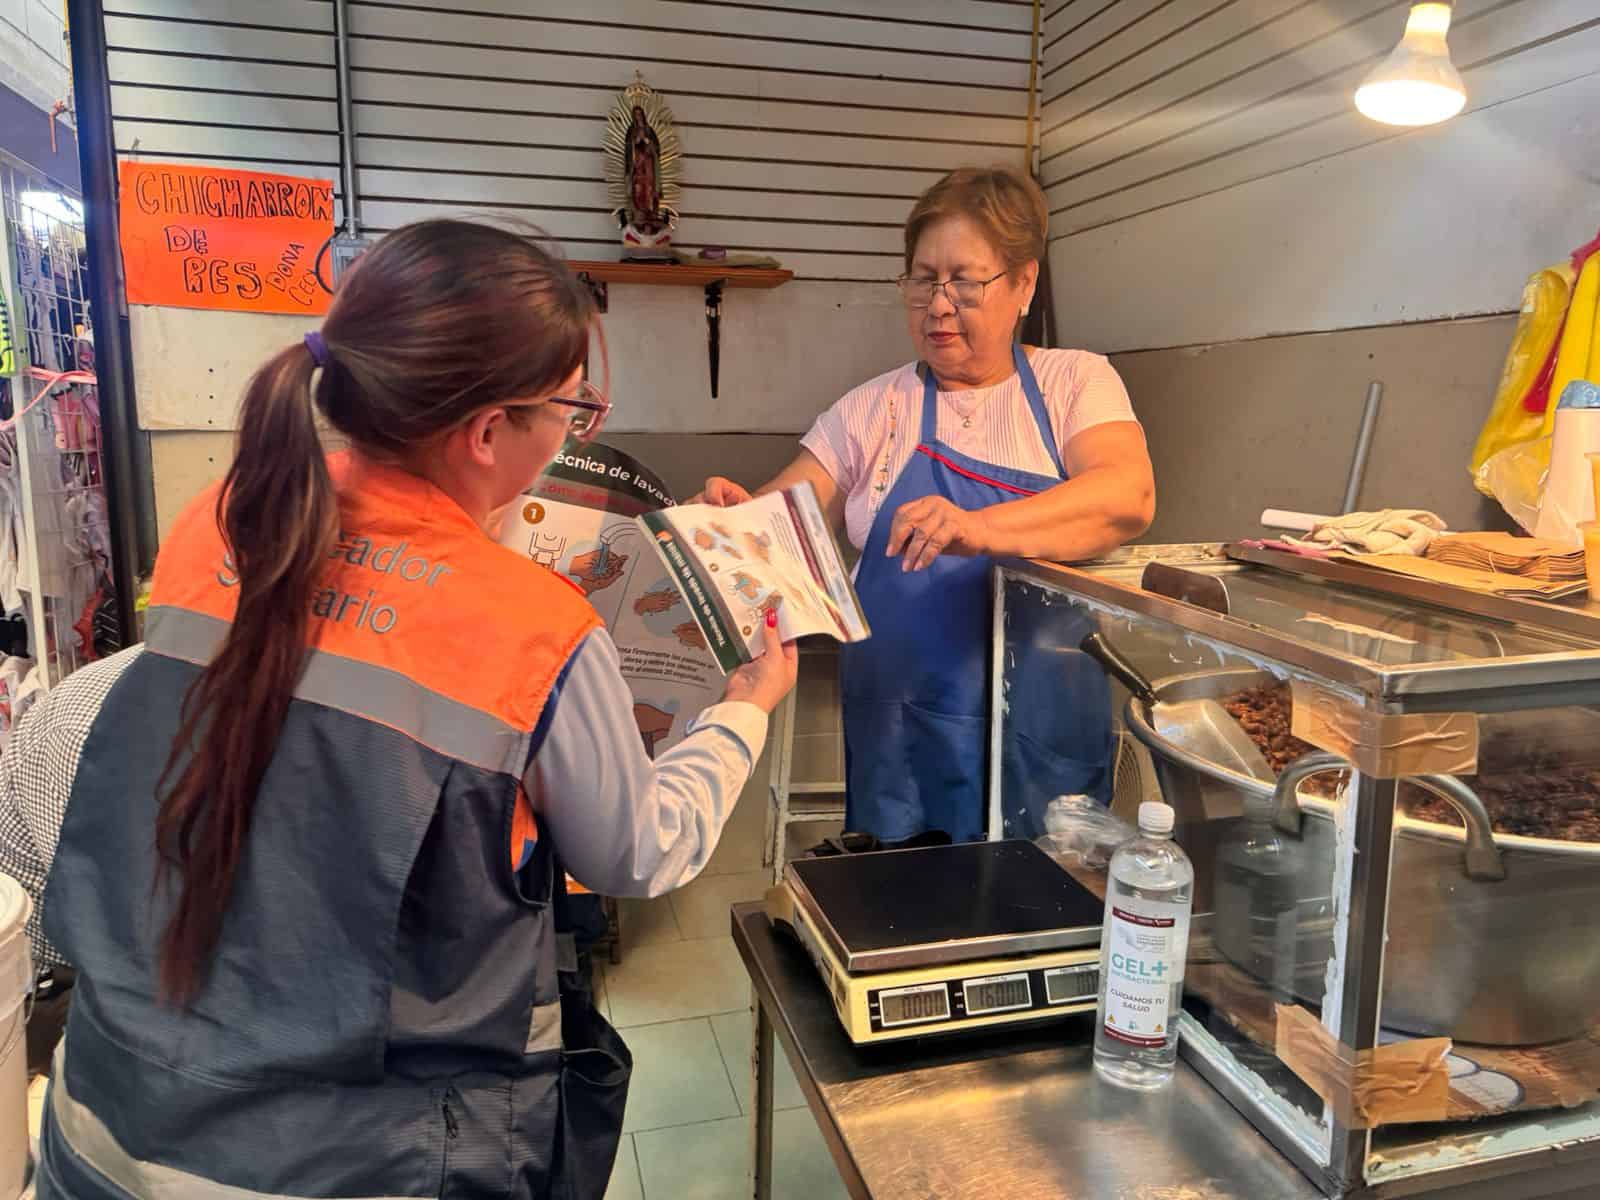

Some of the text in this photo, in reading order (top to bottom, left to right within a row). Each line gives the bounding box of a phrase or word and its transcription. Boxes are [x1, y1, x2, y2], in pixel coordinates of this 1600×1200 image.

[136, 171, 334, 220] CHICHARRON
[164, 225, 208, 254] DE
[183, 256, 263, 300] RES
[553, 449, 605, 475] écnica
[609, 466, 630, 481] de
[633, 474, 679, 508] lavad
[1111, 953, 1169, 977] GEL+
[1122, 1001, 1151, 1013] SALUD
